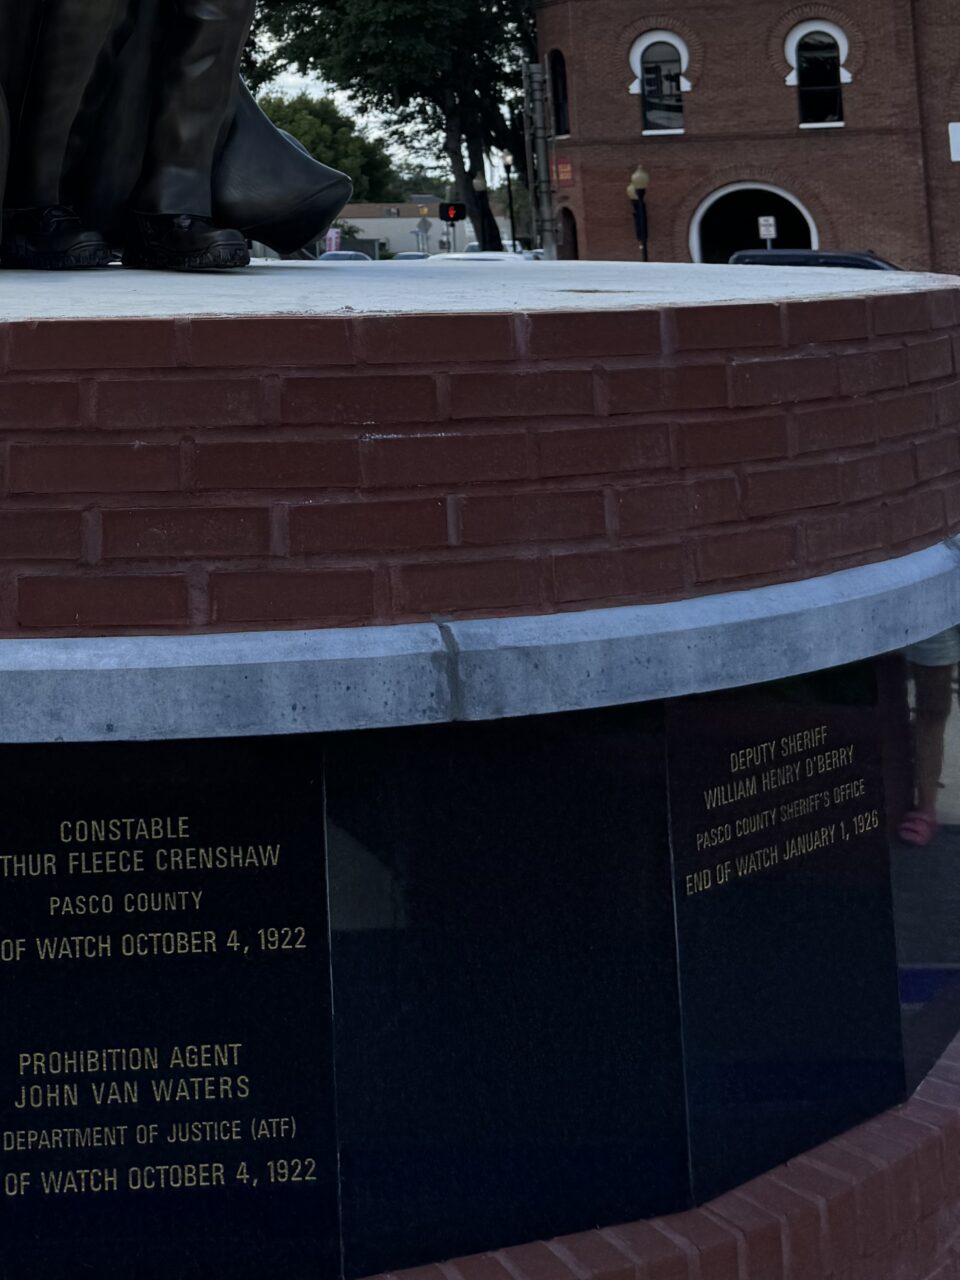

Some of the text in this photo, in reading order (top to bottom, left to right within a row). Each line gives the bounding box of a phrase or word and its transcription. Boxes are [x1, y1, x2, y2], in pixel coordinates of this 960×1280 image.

[730, 725, 828, 773] DEPUTY SHERIFF
[704, 777, 757, 810] WILLIAM
[762, 762, 801, 792] HENRY
[59, 816, 190, 843] CONSTABLE
[696, 824, 731, 850] PASCO
[735, 810, 776, 838] COUNTY
[833, 779, 865, 805] OFFICE
[69, 849, 145, 875] FLEECE
[155, 845, 281, 871] CRENSHAW
[685, 810, 879, 895] END OF WATCH JANUARY 1, 1926
[49, 891, 203, 915] PASCO COUNTY
[1, 938, 26, 961] OF
[36, 935, 111, 959] WATCH
[121, 930, 217, 957] OCTOBER
[226, 929, 250, 955] 4,
[258, 927, 307, 950] 1922
[19, 1043, 242, 1075] PROHIBITION AGENT
[14, 1076, 250, 1109] JOHN VAN WATERS
[3, 1125, 128, 1151] DEPARTMENT
[136, 1124, 159, 1144] OF
[167, 1120, 241, 1142] JUSTICE
[250, 1116, 296, 1140] (ATF)
[5, 1173, 30, 1196] OF
[40, 1169, 118, 1194] WATCH
[128, 1163, 226, 1190] OCTOBER
[236, 1162, 259, 1187] 4,
[267, 1158, 317, 1182] 1922
